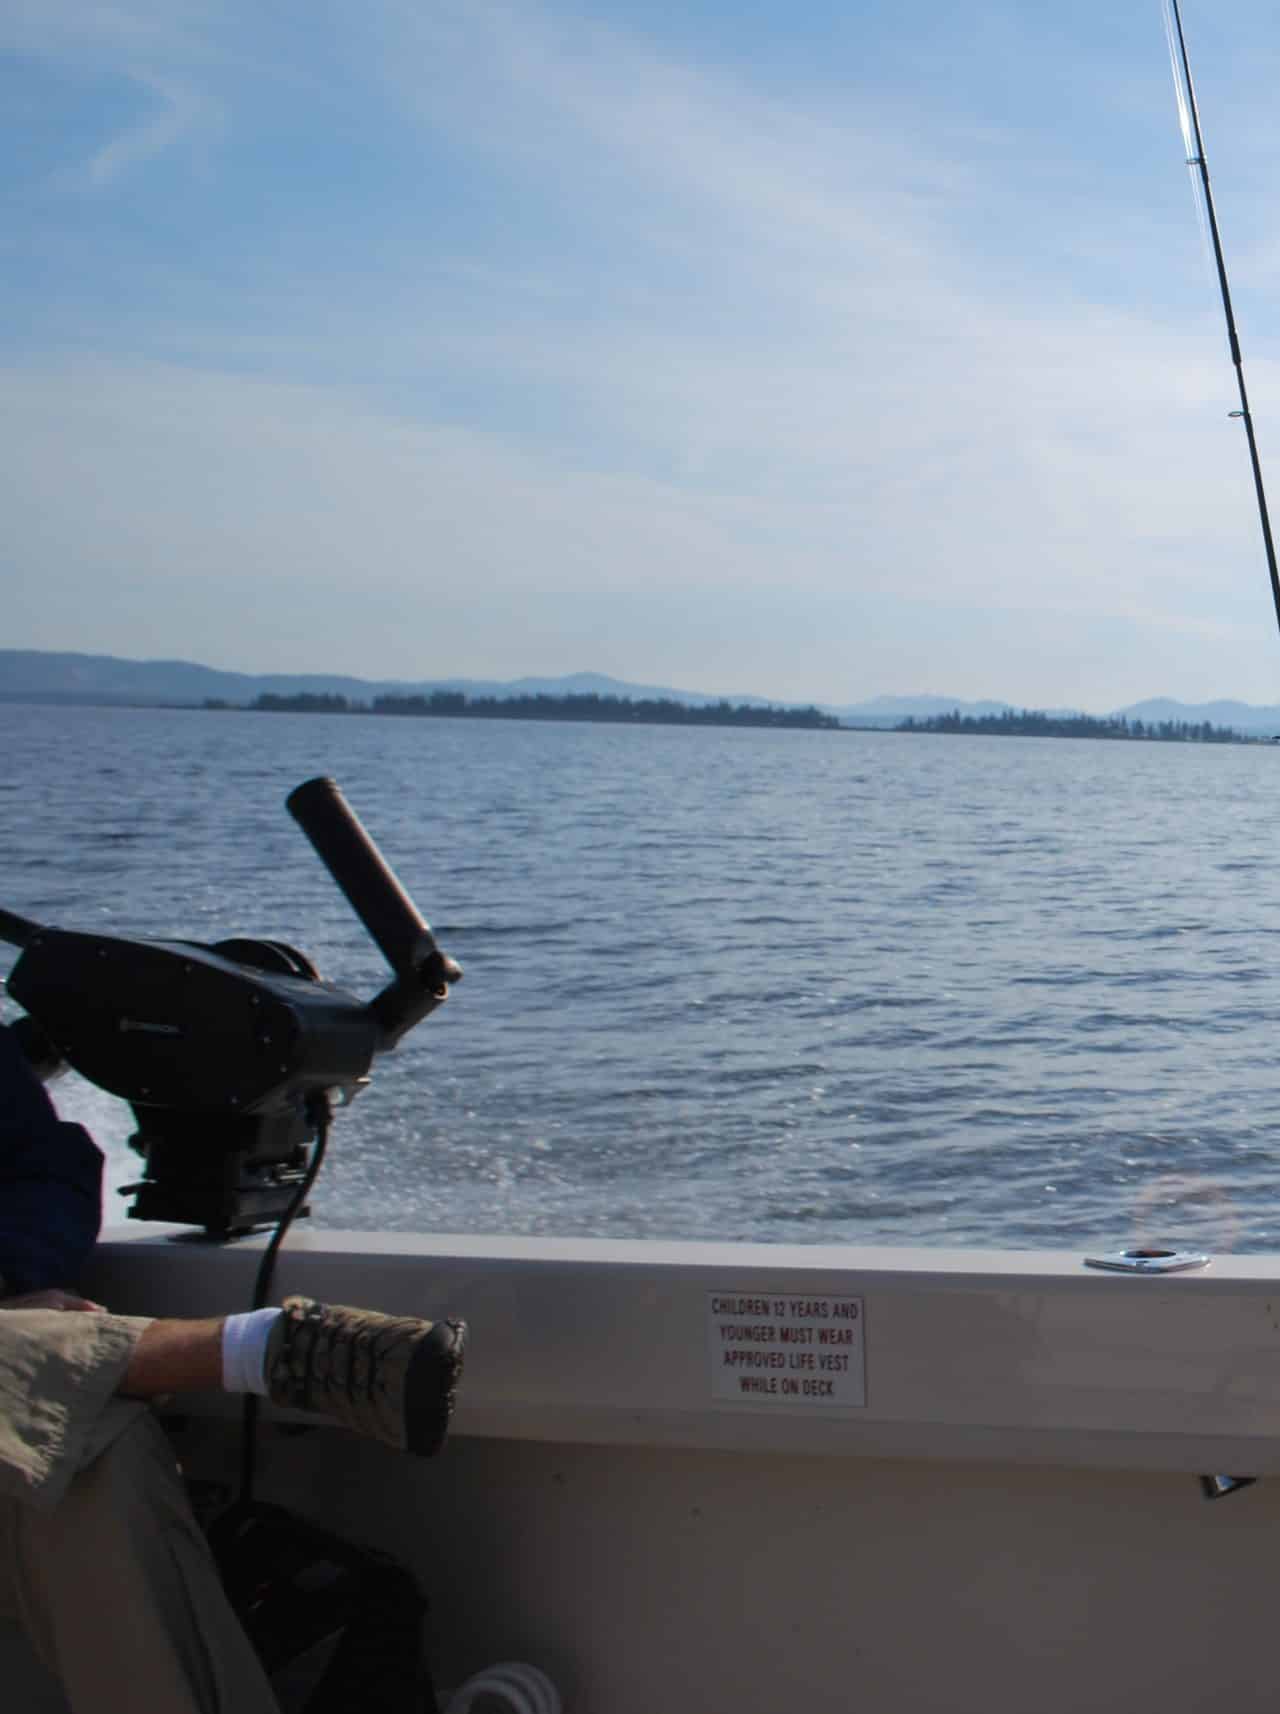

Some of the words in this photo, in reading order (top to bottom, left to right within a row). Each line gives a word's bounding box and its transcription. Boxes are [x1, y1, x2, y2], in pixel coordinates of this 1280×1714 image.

[712, 1298, 770, 1316] CHILDREN
[790, 1301, 829, 1319] YEARS
[832, 1303, 859, 1320] AND
[720, 1325, 776, 1342] YOUNGER
[780, 1327, 813, 1344] MUST
[818, 1328, 853, 1345] WEAR
[723, 1350, 786, 1369] APPROVED
[789, 1353, 816, 1370] LIFE
[819, 1354, 849, 1372] VEST
[738, 1376, 777, 1394] WHILE
[781, 1378, 799, 1395] ON
[802, 1379, 835, 1397] DECK
